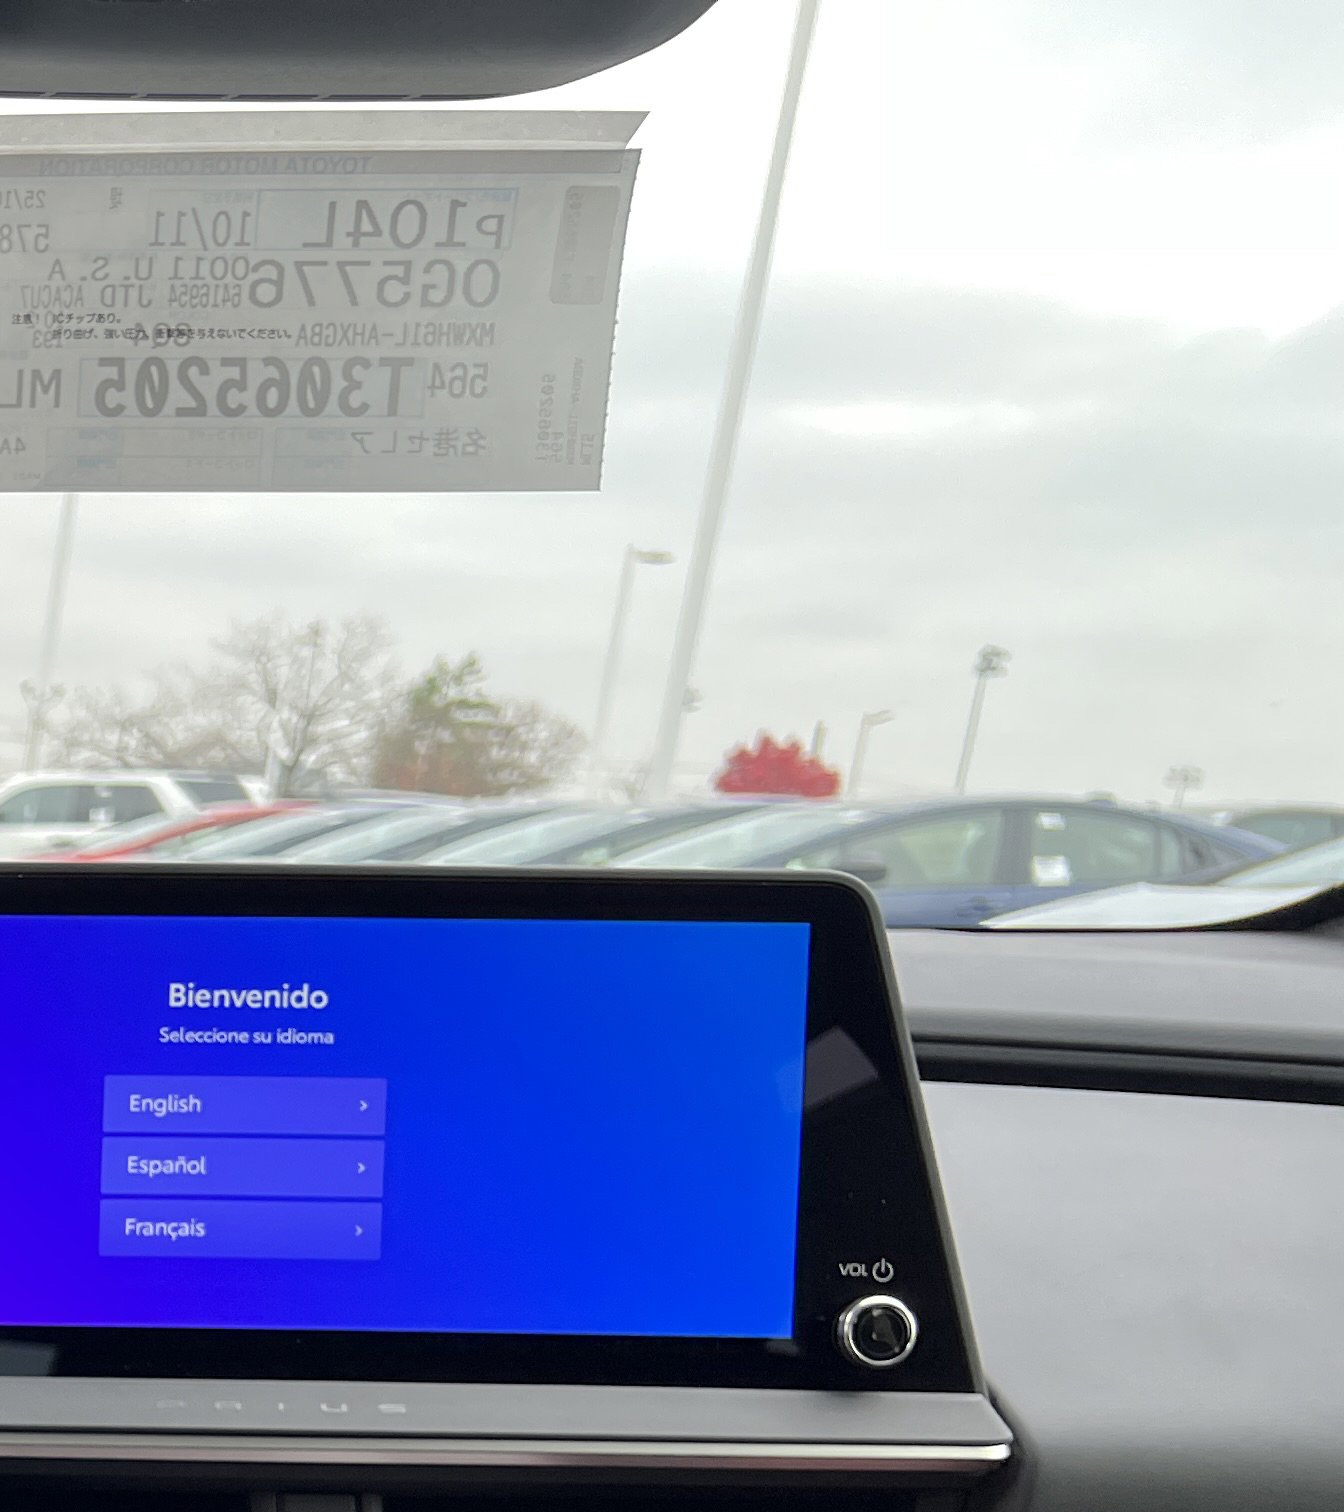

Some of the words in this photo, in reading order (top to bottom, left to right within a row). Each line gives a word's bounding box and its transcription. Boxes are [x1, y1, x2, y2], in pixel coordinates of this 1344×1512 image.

[168, 982, 329, 1010] Bienvenido
[159, 1027, 250, 1045] Seleccione
[253, 1030, 272, 1045] su
[276, 1028, 335, 1045] idioma
[129, 1094, 201, 1118] English
[126, 1155, 207, 1178] Español
[124, 1218, 206, 1241] Français
[838, 1262, 869, 1277] VOL
